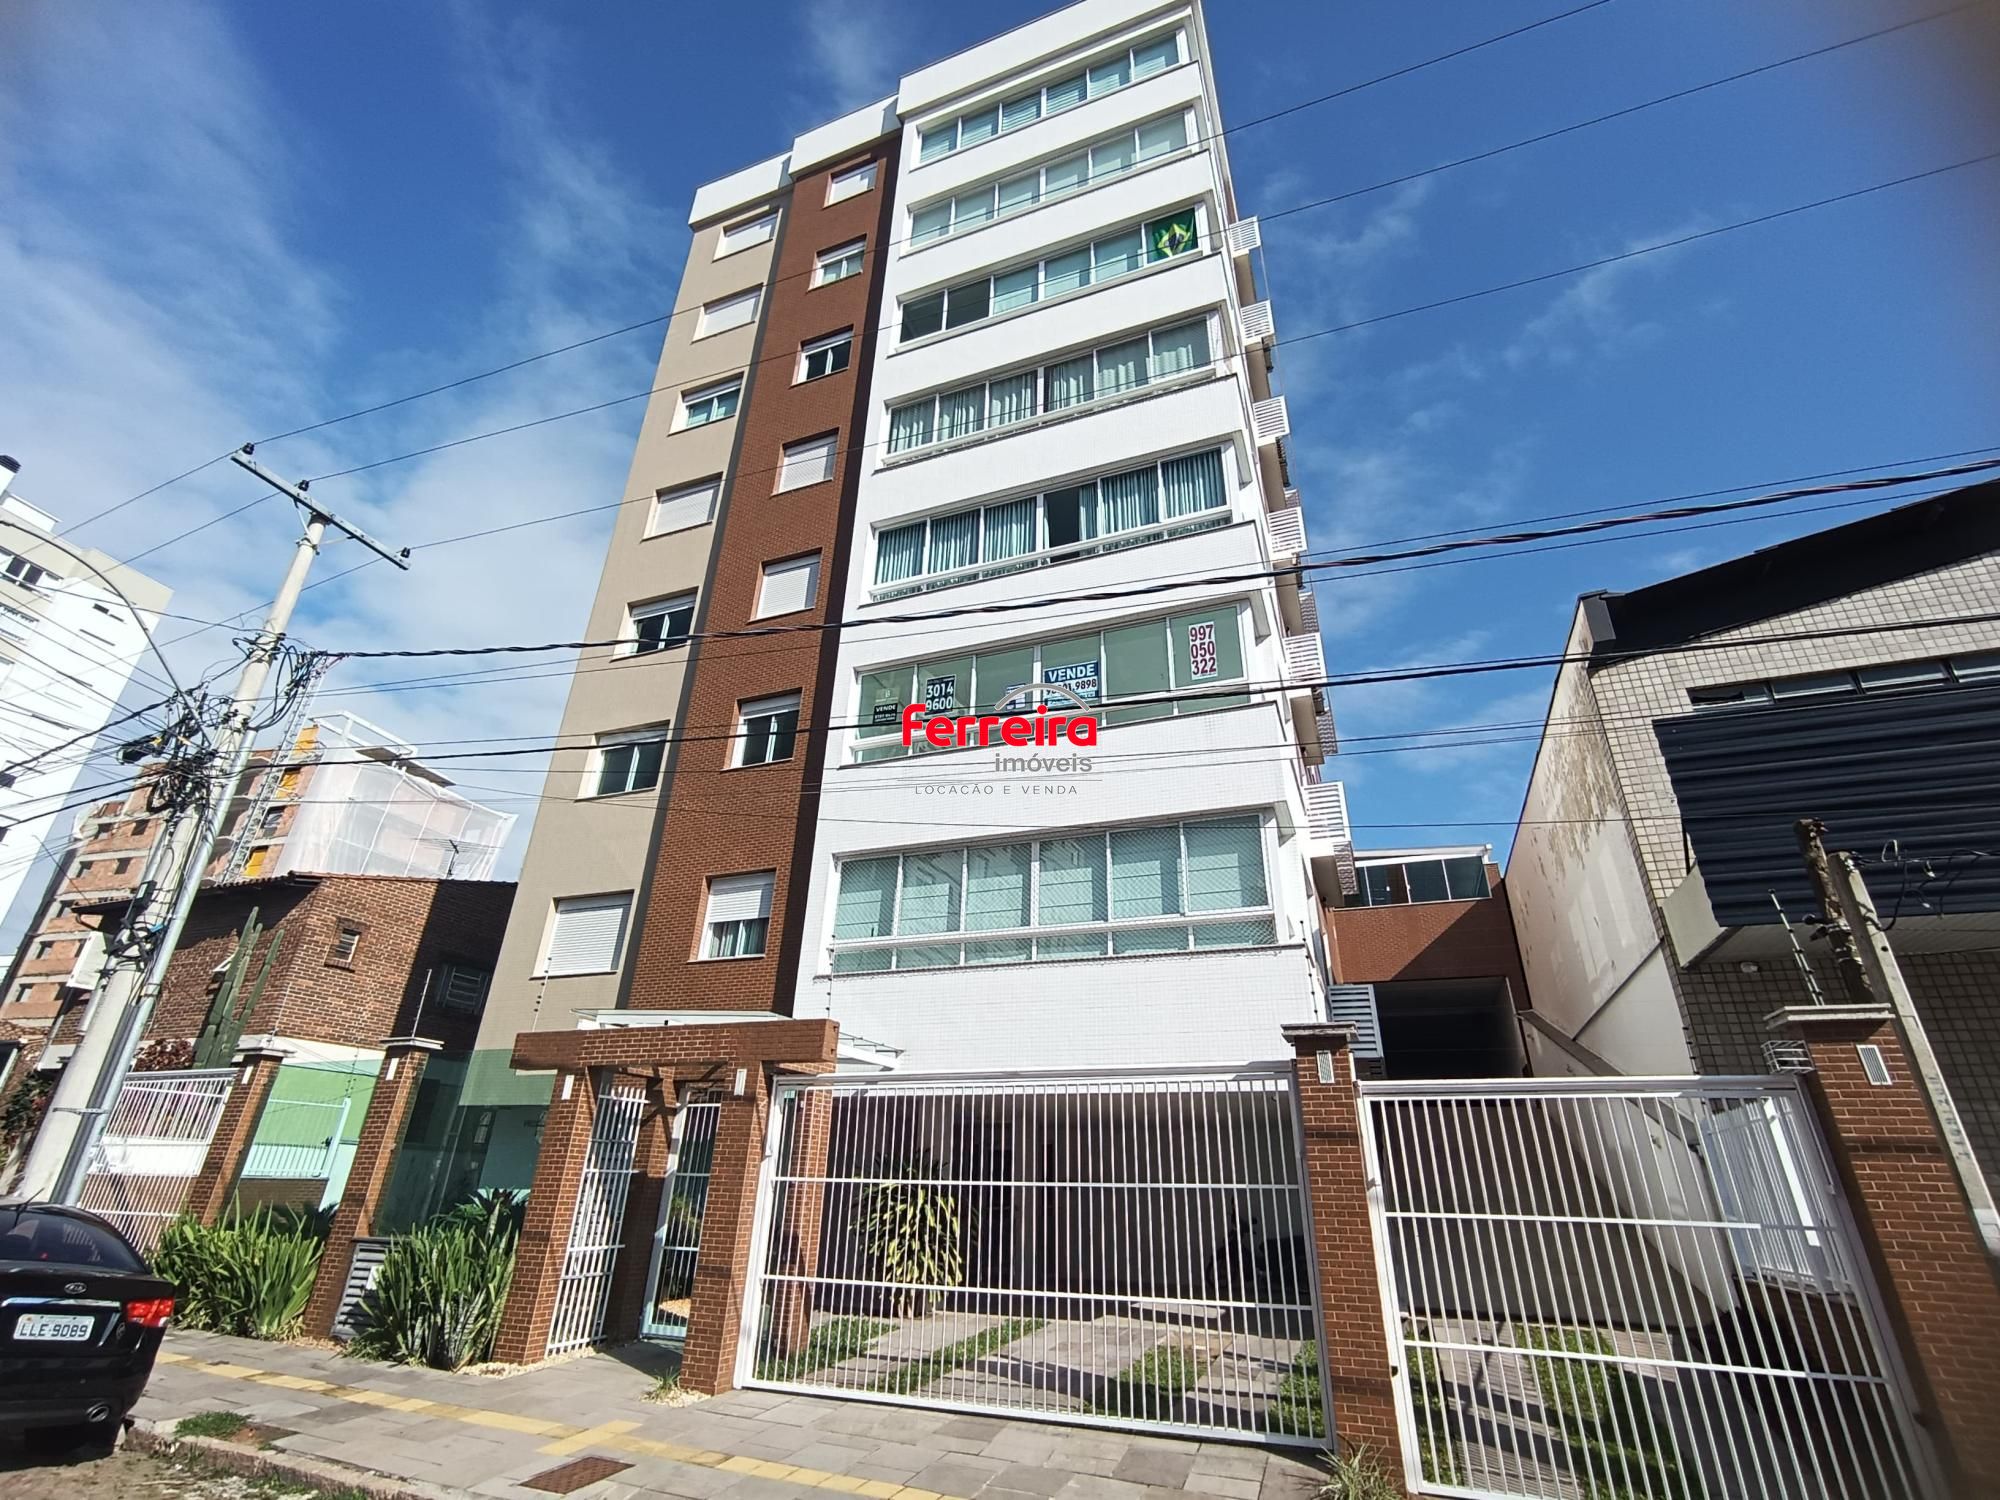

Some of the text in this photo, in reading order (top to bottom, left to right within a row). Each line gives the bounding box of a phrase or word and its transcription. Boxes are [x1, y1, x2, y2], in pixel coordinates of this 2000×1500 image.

[1190, 624, 1213, 642] 997
[1190, 641, 1215, 659] 050
[1048, 664, 1095, 682] VENDE
[1192, 657, 1216, 675] 322
[926, 682, 953, 698] 3014
[875, 704, 896, 712] VENDE
[926, 696, 953, 711] 9600
